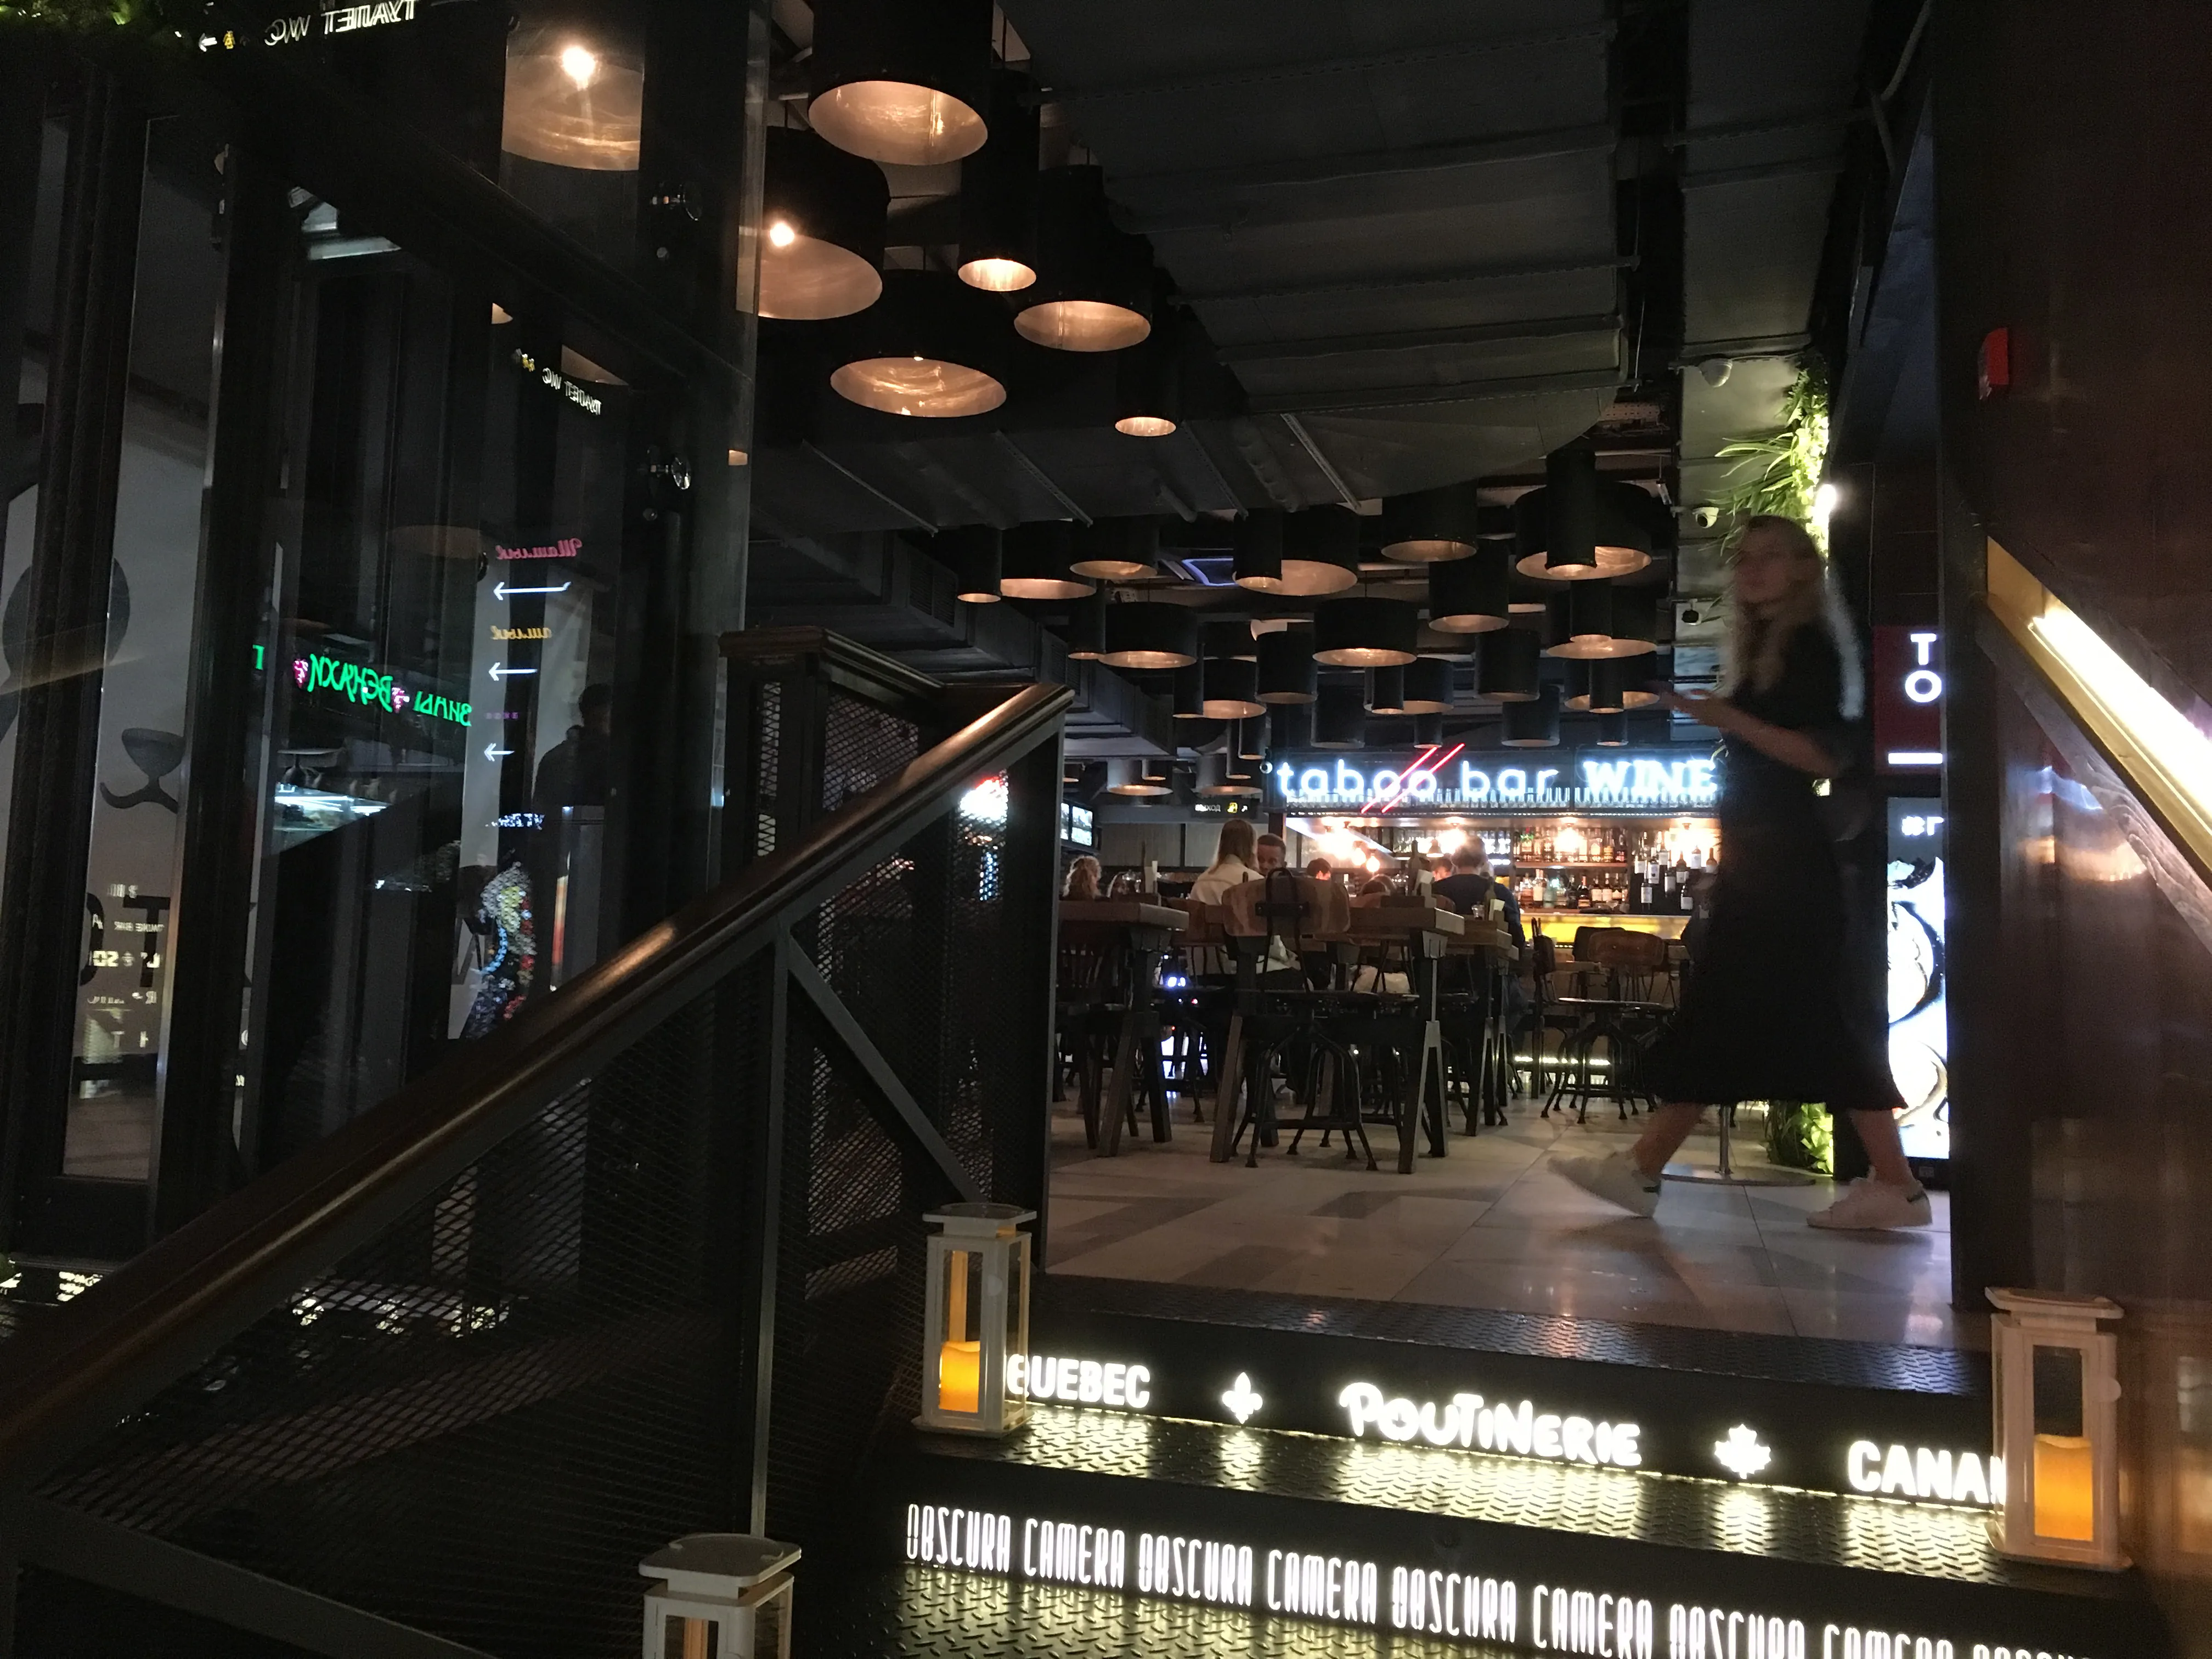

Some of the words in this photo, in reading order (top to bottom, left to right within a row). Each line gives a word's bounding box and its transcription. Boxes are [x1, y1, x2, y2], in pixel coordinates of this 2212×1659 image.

[1276, 759, 1437, 798] taboo
[1462, 760, 1559, 798] bar
[1583, 759, 1718, 797] WINE
[1007, 1353, 1150, 1409] QUEBEC
[906, 1504, 1011, 1573] OBSCURA
[1024, 1518, 1125, 1589] CAMERA
[1138, 1533, 1253, 1606] OBSCURA
[1267, 1549, 1378, 1624] CAMERA
[1392, 1566, 1516, 1643] OBSCURA
[1533, 1584, 1653, 1659] CAMERA
